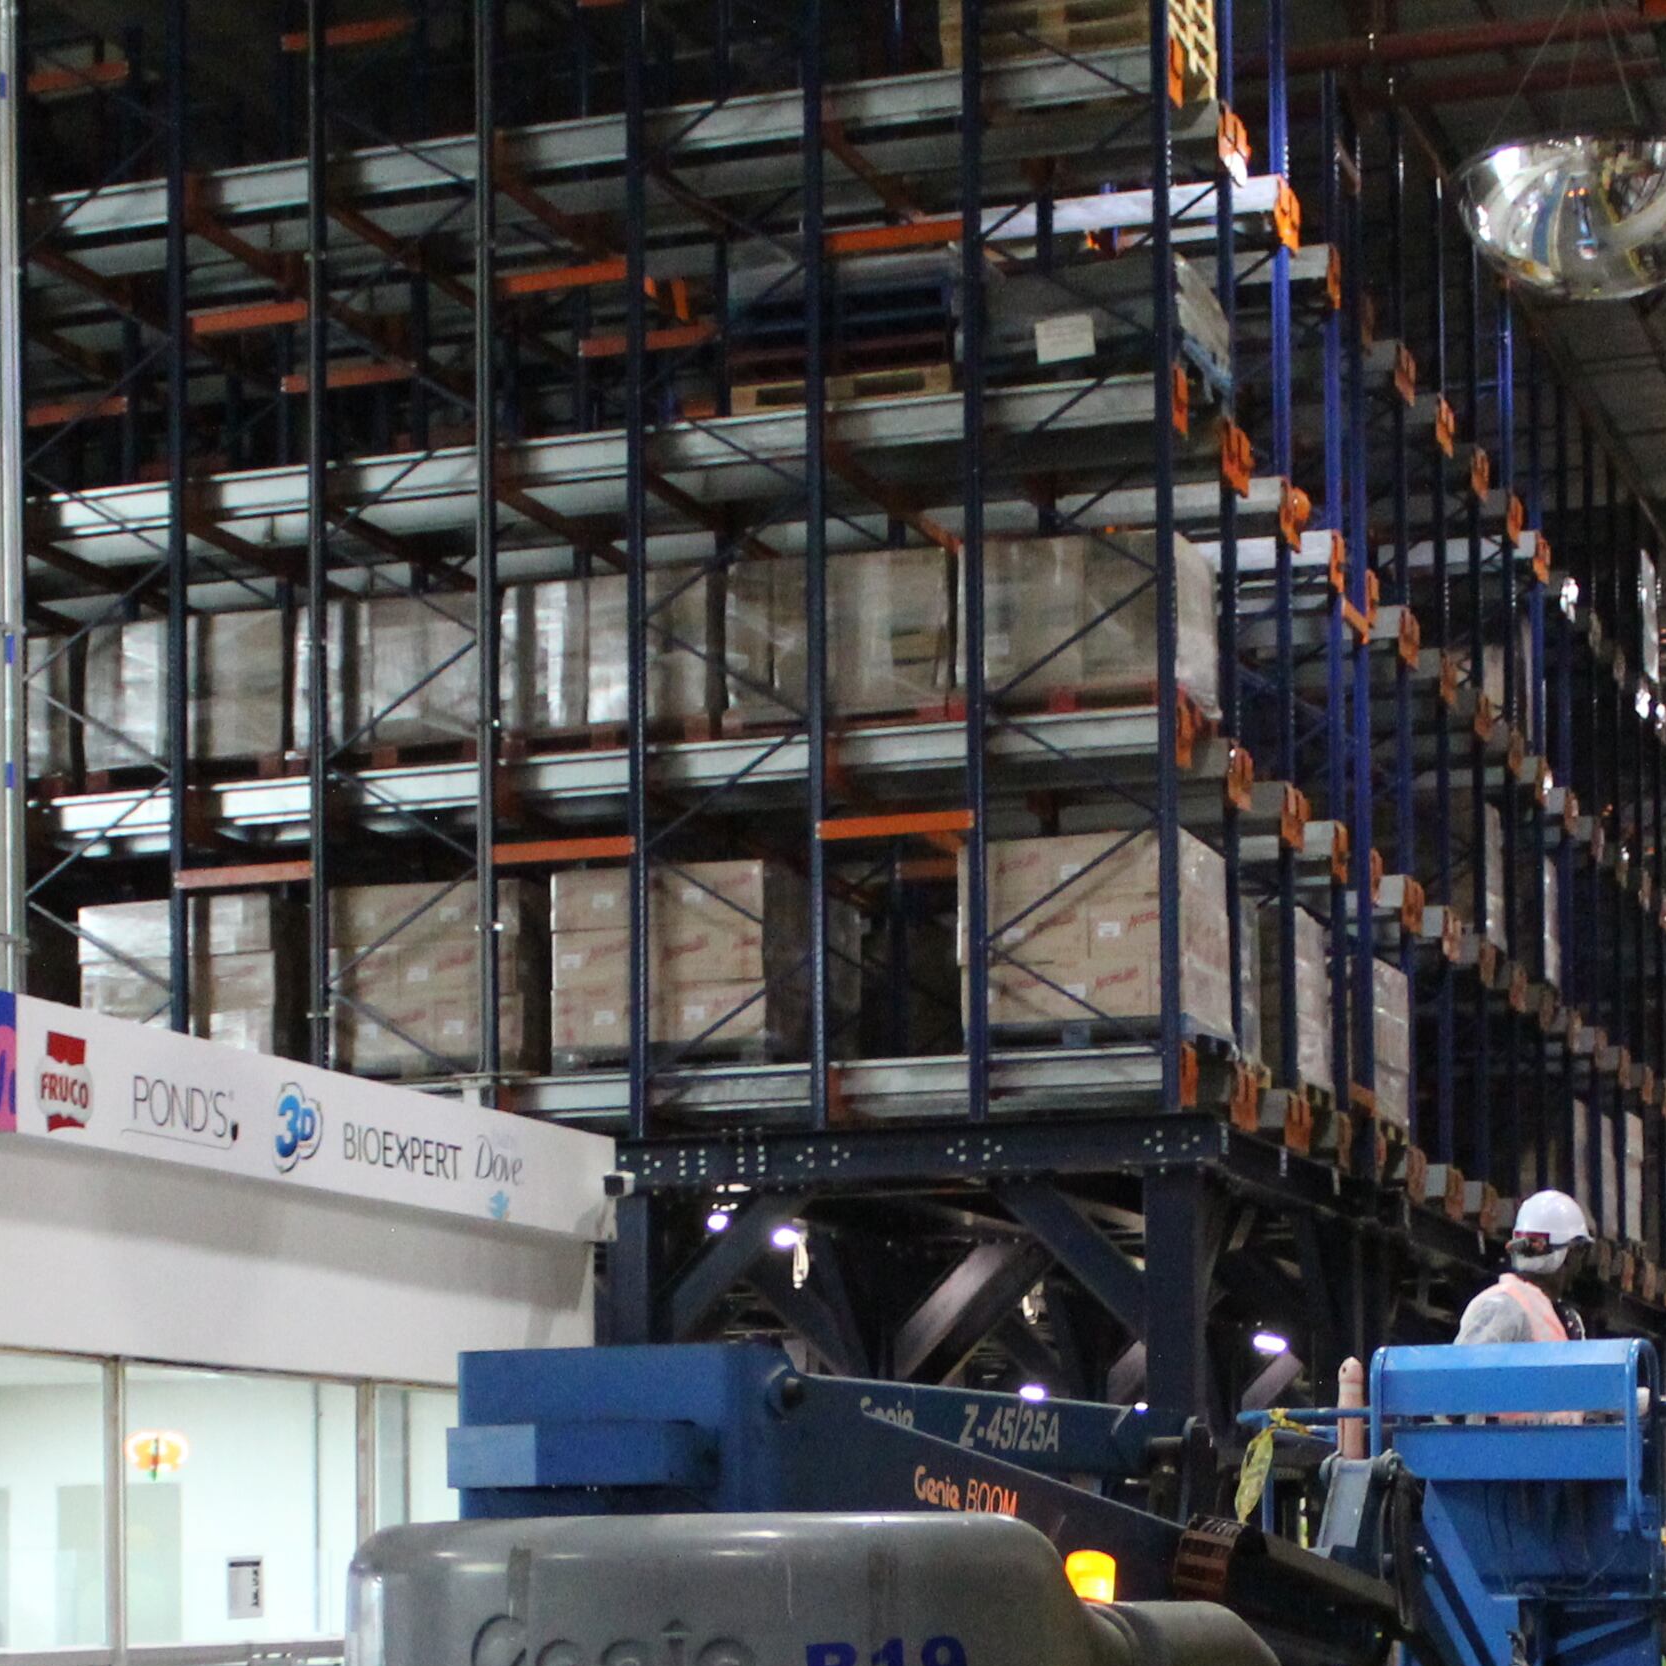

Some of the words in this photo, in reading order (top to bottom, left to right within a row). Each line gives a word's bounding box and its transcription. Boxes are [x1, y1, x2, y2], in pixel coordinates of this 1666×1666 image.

[40, 1072, 89, 1109] FRUCO
[134, 1074, 228, 1138] POND'S
[275, 1095, 317, 1158] 3D
[343, 1122, 461, 1180] BIOEXPERT
[475, 1134, 524, 1186] Dove
[958, 1402, 1060, 1452] Z-45/25A
[914, 1465, 960, 1510] Genie
[965, 1479, 1018, 1516] BOOM
